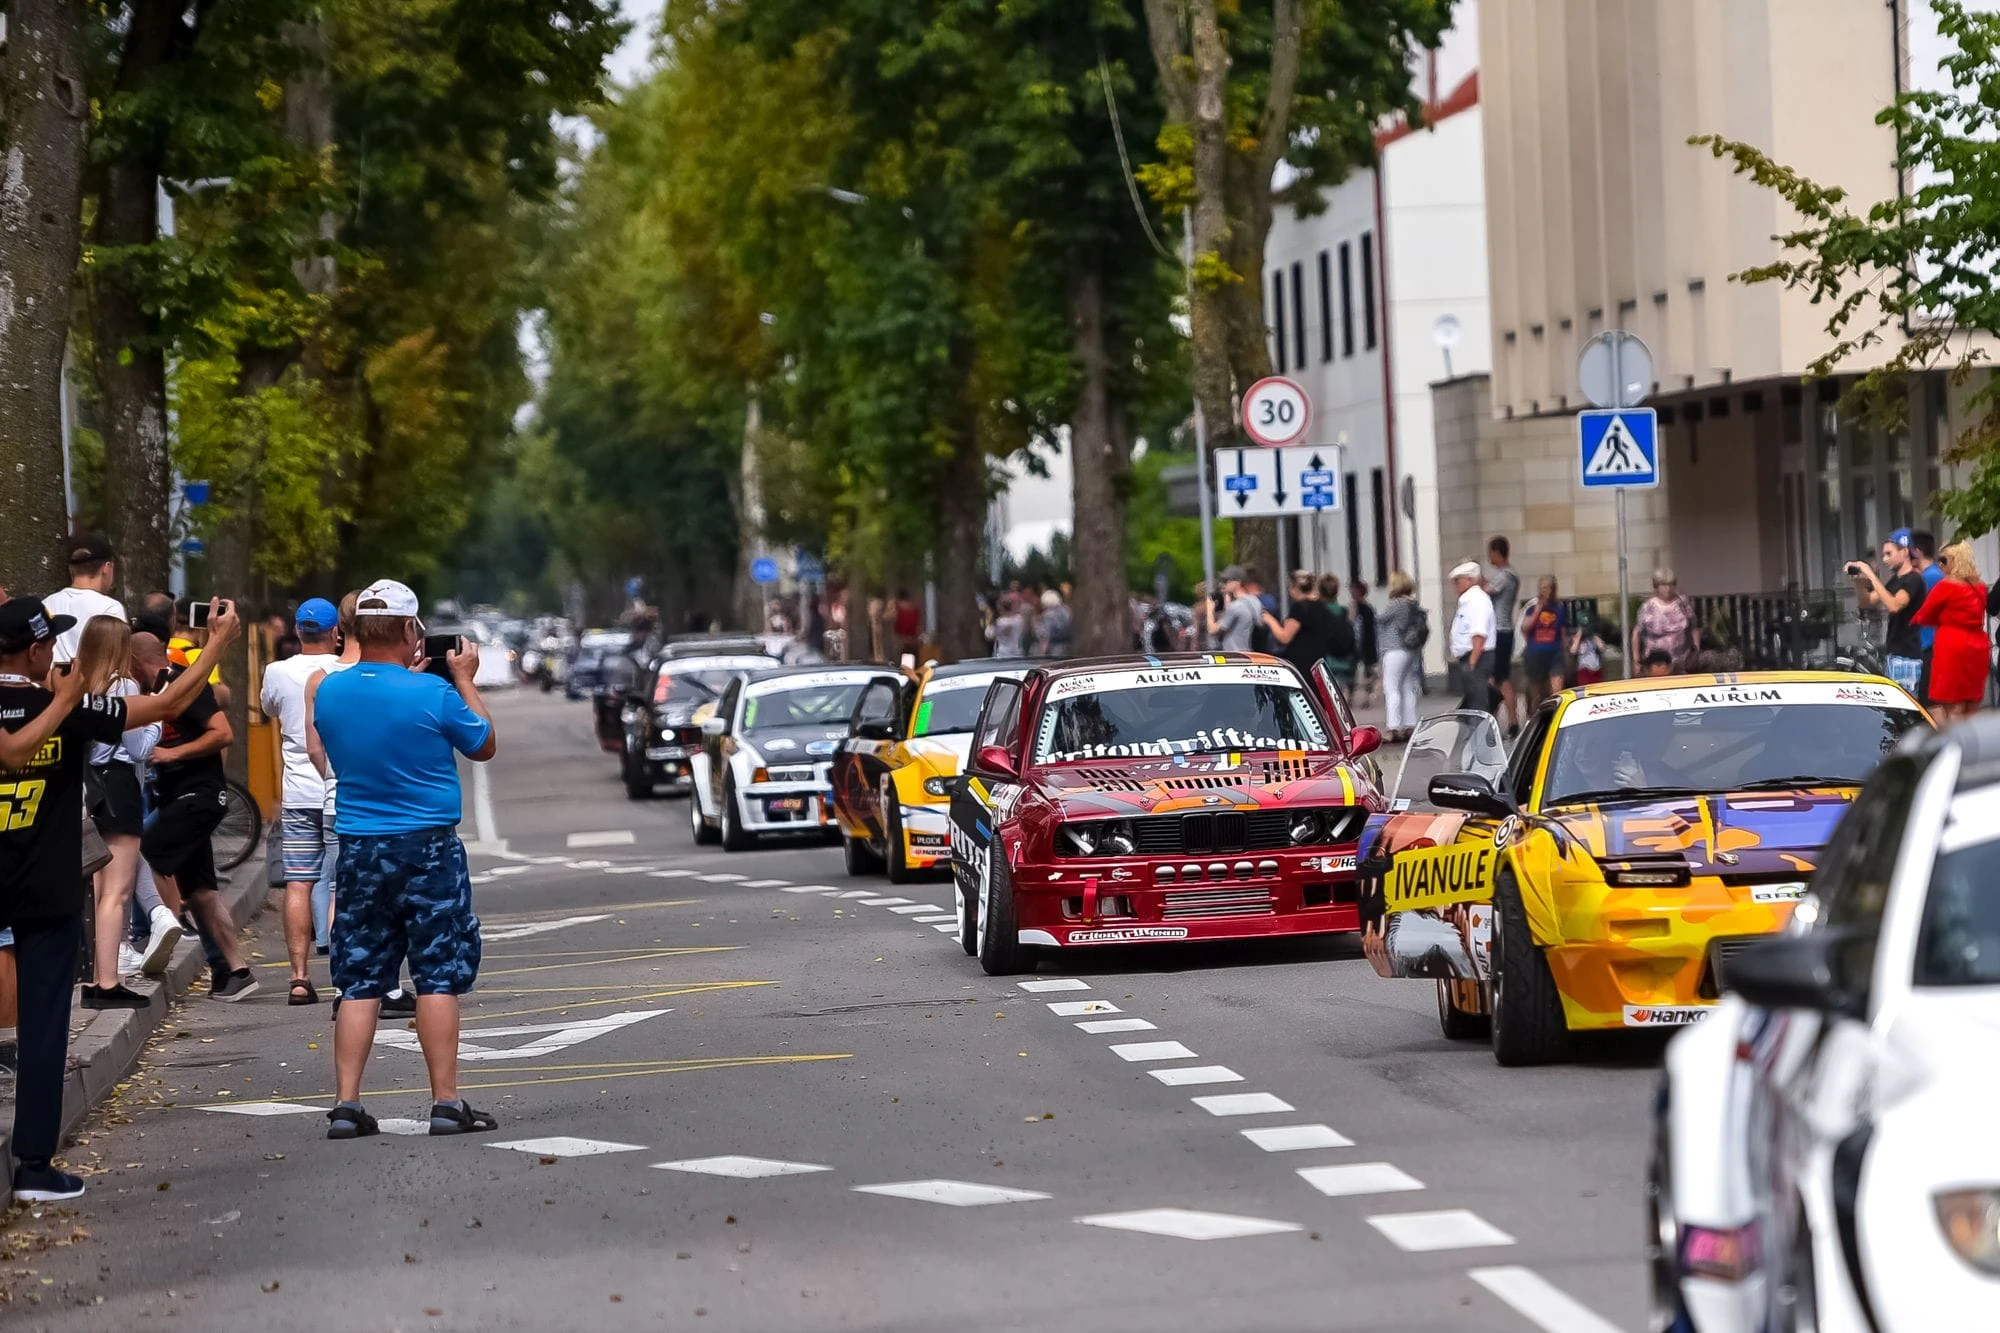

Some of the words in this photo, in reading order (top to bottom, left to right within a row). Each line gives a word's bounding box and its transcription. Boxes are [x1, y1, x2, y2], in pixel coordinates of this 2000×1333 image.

[1260, 399, 1294, 424] 30
[1135, 671, 1201, 684] AURUM
[1692, 689, 1782, 704] AURUM
[1395, 849, 1490, 900] IVANULE
